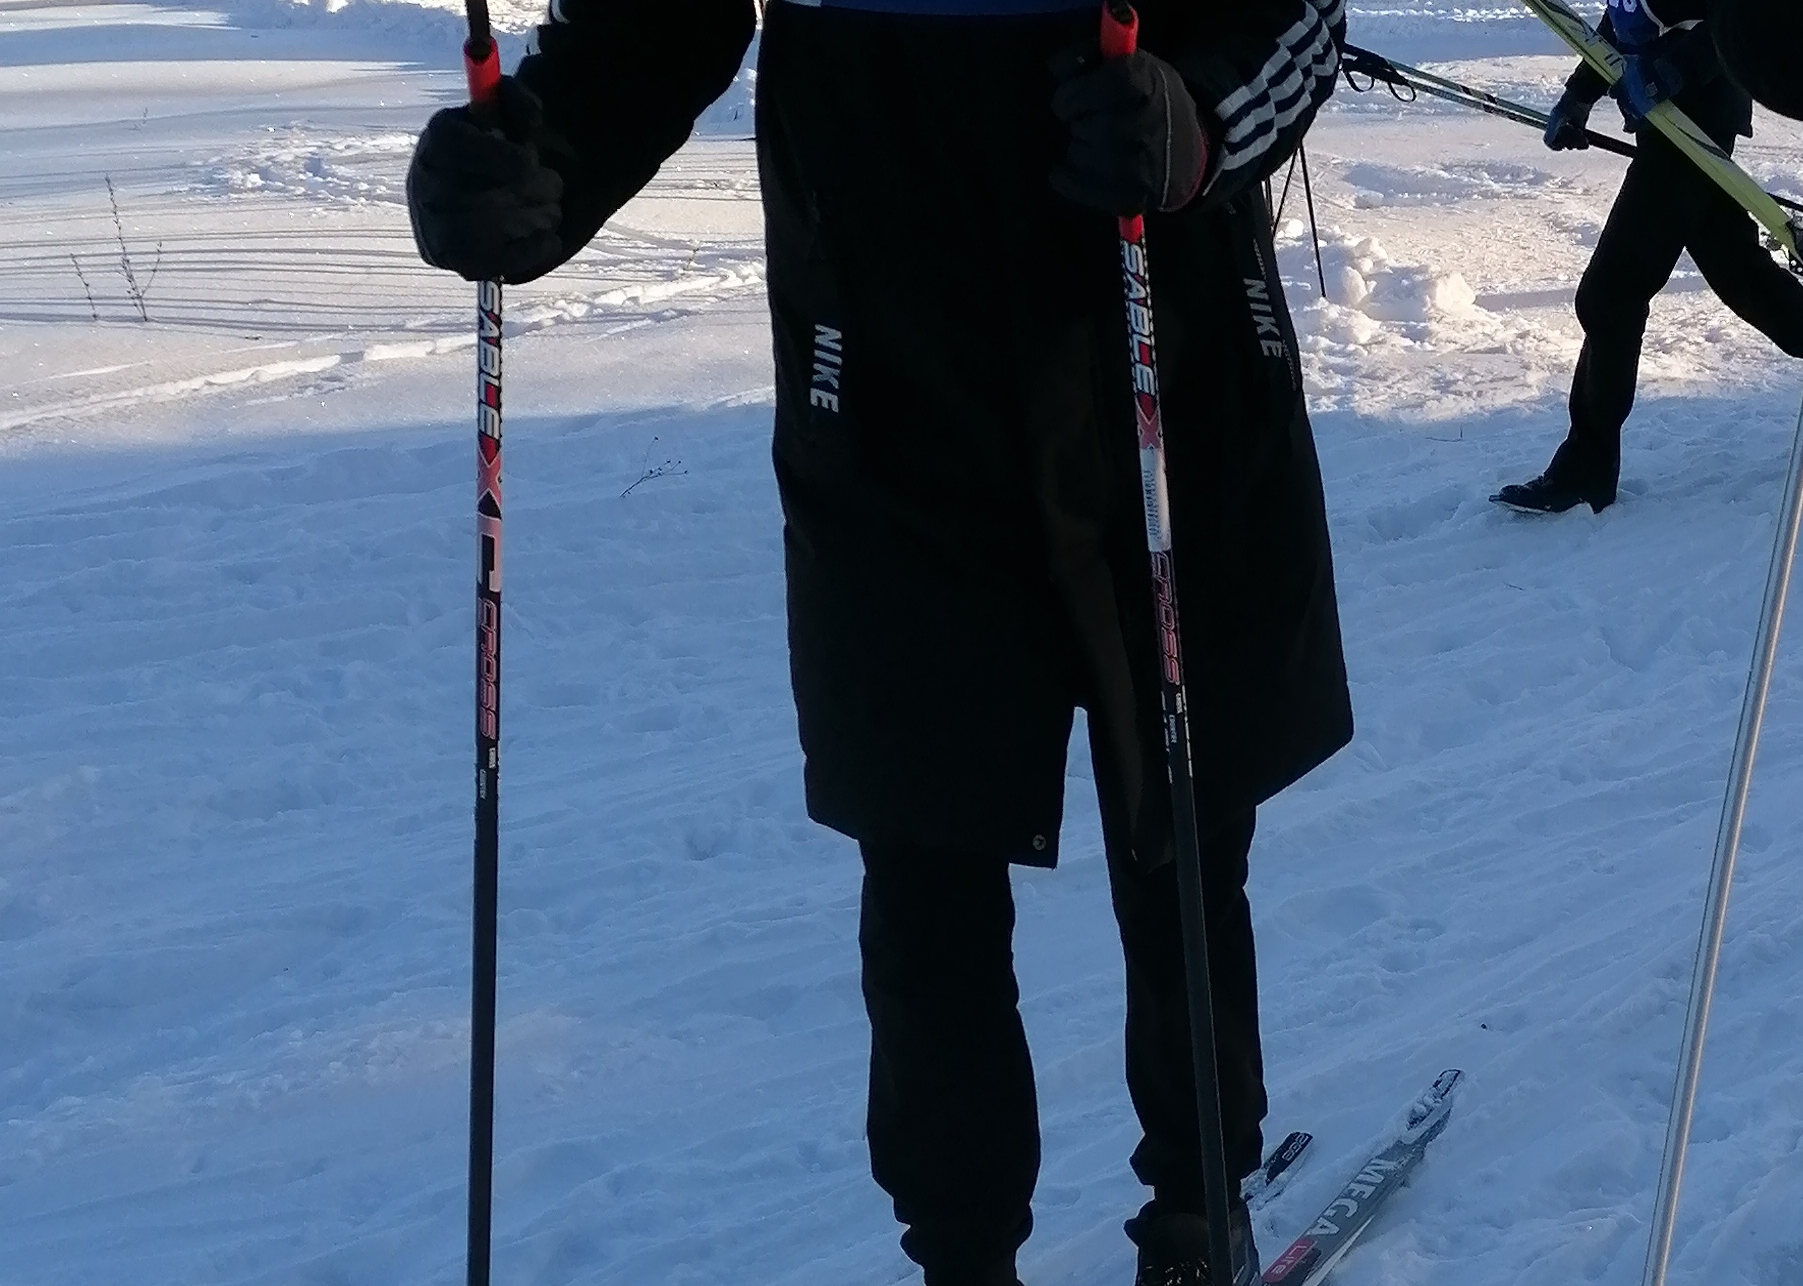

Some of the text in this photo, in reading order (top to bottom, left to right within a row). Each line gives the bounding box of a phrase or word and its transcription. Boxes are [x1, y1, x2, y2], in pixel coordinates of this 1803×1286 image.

[479, 280, 500, 440] SABLE
[1122, 240, 1156, 396] SABLE
[1243, 278, 1282, 358] NIKE
[810, 323, 843, 413] NIKE
[1306, 1158, 1398, 1236] MEGA
